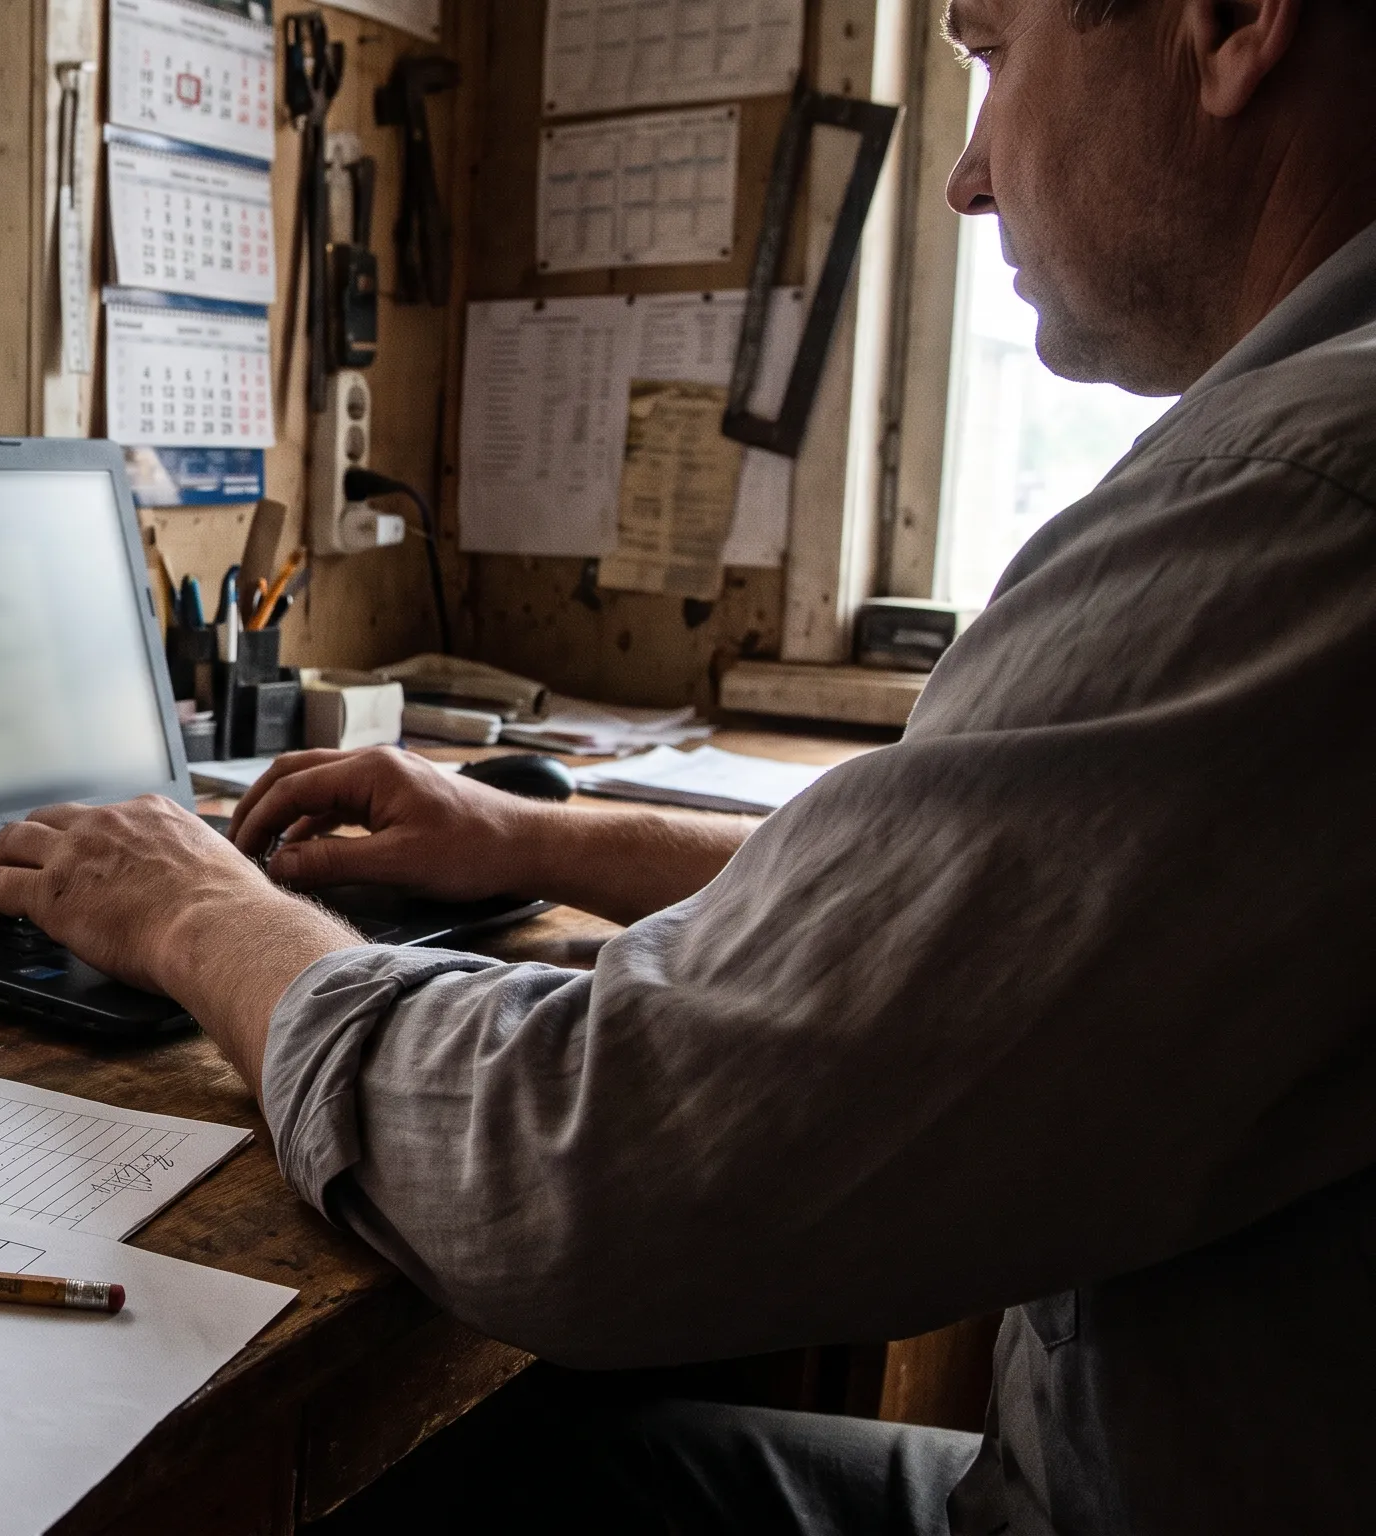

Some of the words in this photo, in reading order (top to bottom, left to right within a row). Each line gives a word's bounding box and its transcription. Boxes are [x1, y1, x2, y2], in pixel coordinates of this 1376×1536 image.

[143, 367, 150, 379] 4
[185, 369, 191, 381] 6
[140, 384, 152, 396] 11
[162, 385, 174, 398] 12
[183, 386, 195, 399] 13
[202, 388, 214, 400] 14
[140, 419, 154, 433] 25
[183, 421, 195, 434] 27
